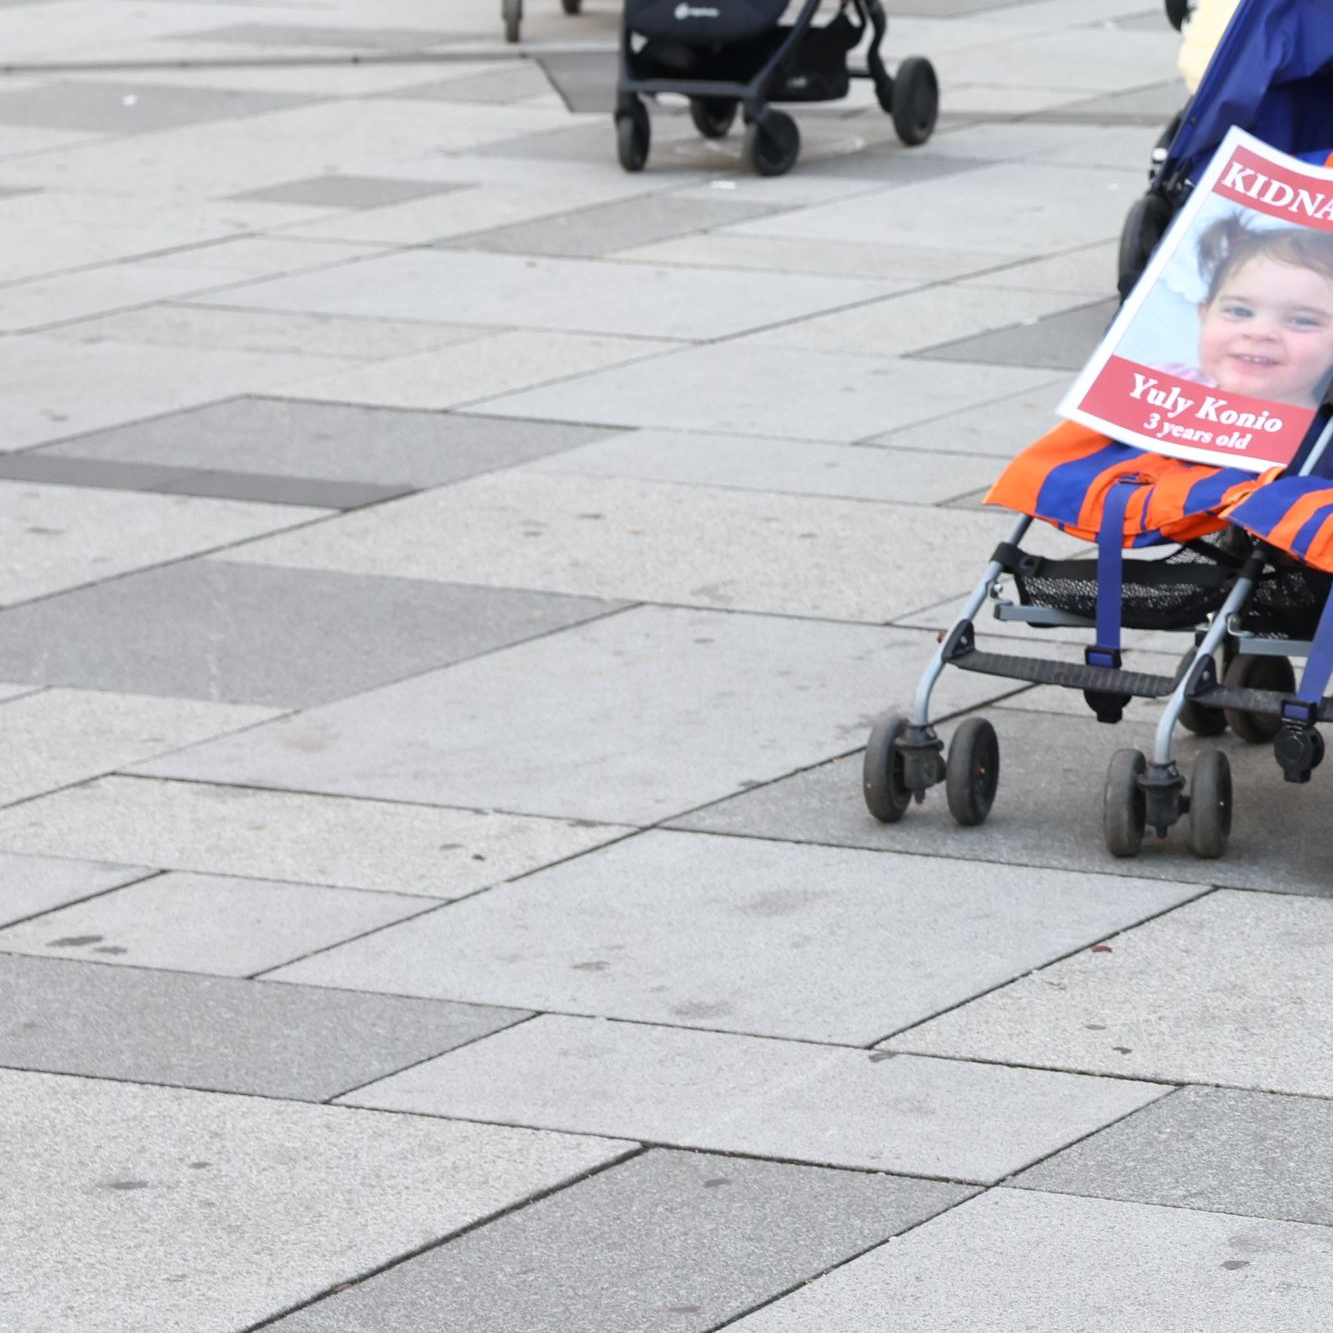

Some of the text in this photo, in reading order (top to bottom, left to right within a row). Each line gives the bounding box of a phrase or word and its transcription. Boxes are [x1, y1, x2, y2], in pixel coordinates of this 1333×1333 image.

[1129, 372, 1283, 434] Yuly Konio
[1143, 413, 1252, 450] 3 years old
